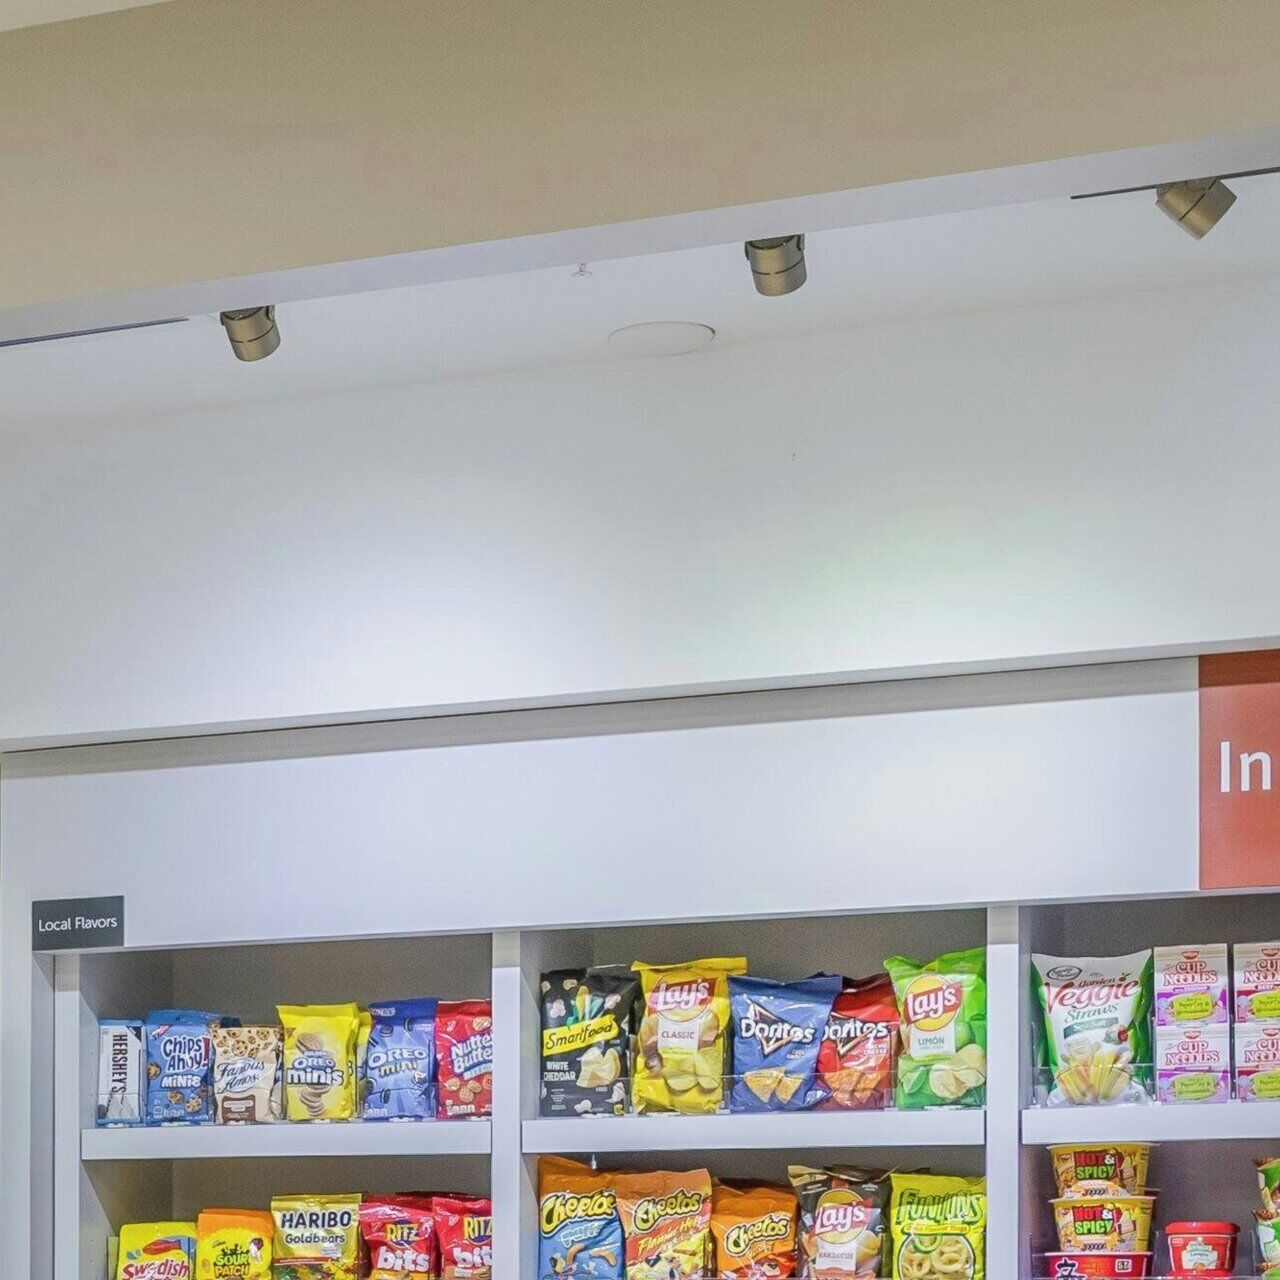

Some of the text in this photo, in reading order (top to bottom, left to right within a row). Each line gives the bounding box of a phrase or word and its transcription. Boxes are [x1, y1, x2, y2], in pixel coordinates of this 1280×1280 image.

[1220, 741, 1271, 793] In
[38, 917, 117, 932] Local Flavors
[1176, 961, 1207, 973] CUP
[1079, 977, 1116, 988] Garden
[1164, 970, 1218, 985] NOODLES
[656, 979, 710, 1011] Lay's
[906, 985, 959, 1022] Lay's
[1044, 980, 1139, 1014] Veggie
[1066, 1003, 1118, 1023] Straws
[546, 1021, 613, 1050] Smartfood
[662, 1031, 695, 1040] CLASSIC
[740, 1018, 815, 1045] Doritos
[162, 1035, 202, 1058] Chips
[451, 1034, 492, 1057] Nutte
[1178, 1041, 1208, 1053] CUP
[293, 1057, 335, 1068] OREO
[369, 1048, 428, 1068] OREO
[453, 1049, 492, 1073] Butte
[546, 1061, 569, 1071] WHITE
[1165, 1051, 1220, 1065] NOODLES
[286, 1068, 344, 1086] minis
[1074, 1151, 1115, 1166] HOT &
[1076, 1165, 1114, 1180] SPICY
[281, 1211, 352, 1229] HARIBO
[541, 1190, 616, 1238] Cheetos
[634, 1190, 702, 1233] Cheetos
[815, 1202, 867, 1234] Lay's
[1072, 1206, 1113, 1220] HOT &
[386, 1222, 420, 1241] RITZ
[725, 1213, 790, 1256] Cheetos
[1074, 1220, 1113, 1234] SPICY
[285, 1233, 346, 1245] Goldbears
[216, 1252, 251, 1266] SOUR
[376, 1246, 430, 1272] bits
[453, 1246, 492, 1269] bit
[214, 1264, 250, 1279] PATCH
